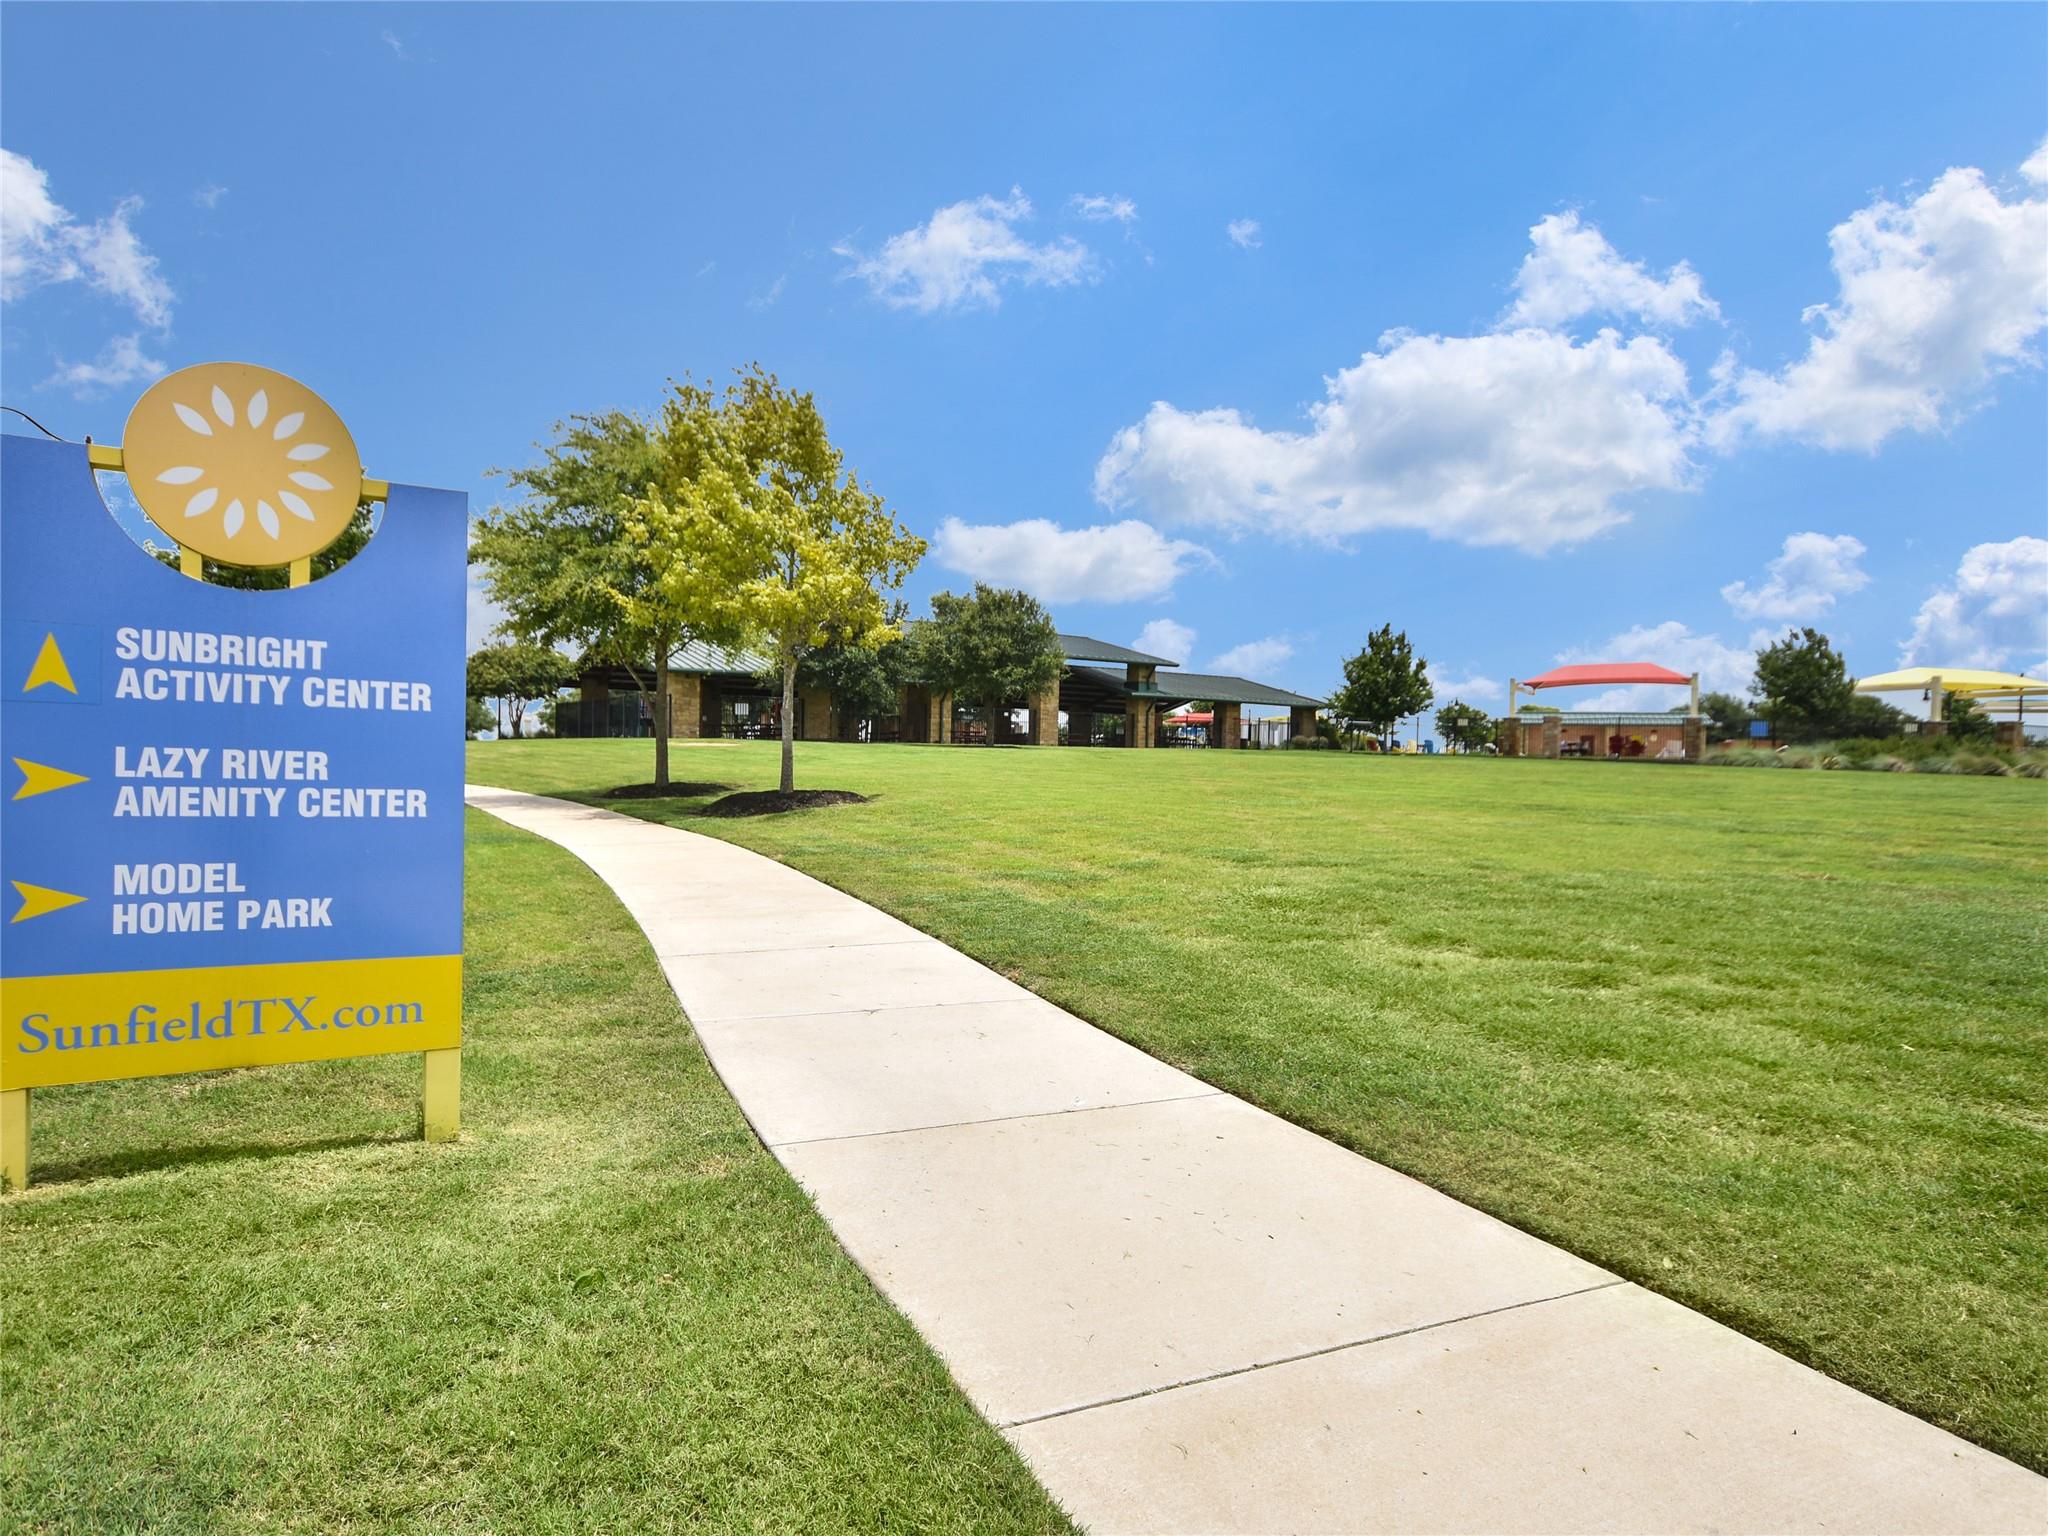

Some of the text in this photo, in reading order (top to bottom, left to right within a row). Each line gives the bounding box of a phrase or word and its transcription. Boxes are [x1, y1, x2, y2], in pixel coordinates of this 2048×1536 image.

[116, 627, 327, 671] SUNBRIGHT
[115, 667, 432, 712] ACTIVITY CENTER
[115, 746, 329, 781] LAZY RIVER
[113, 786, 427, 818] AMENITY CENTER
[114, 863, 246, 896] MODEL
[112, 897, 333, 935] HOME PARK
[18, 995, 424, 1055] SunfieldTX.com
